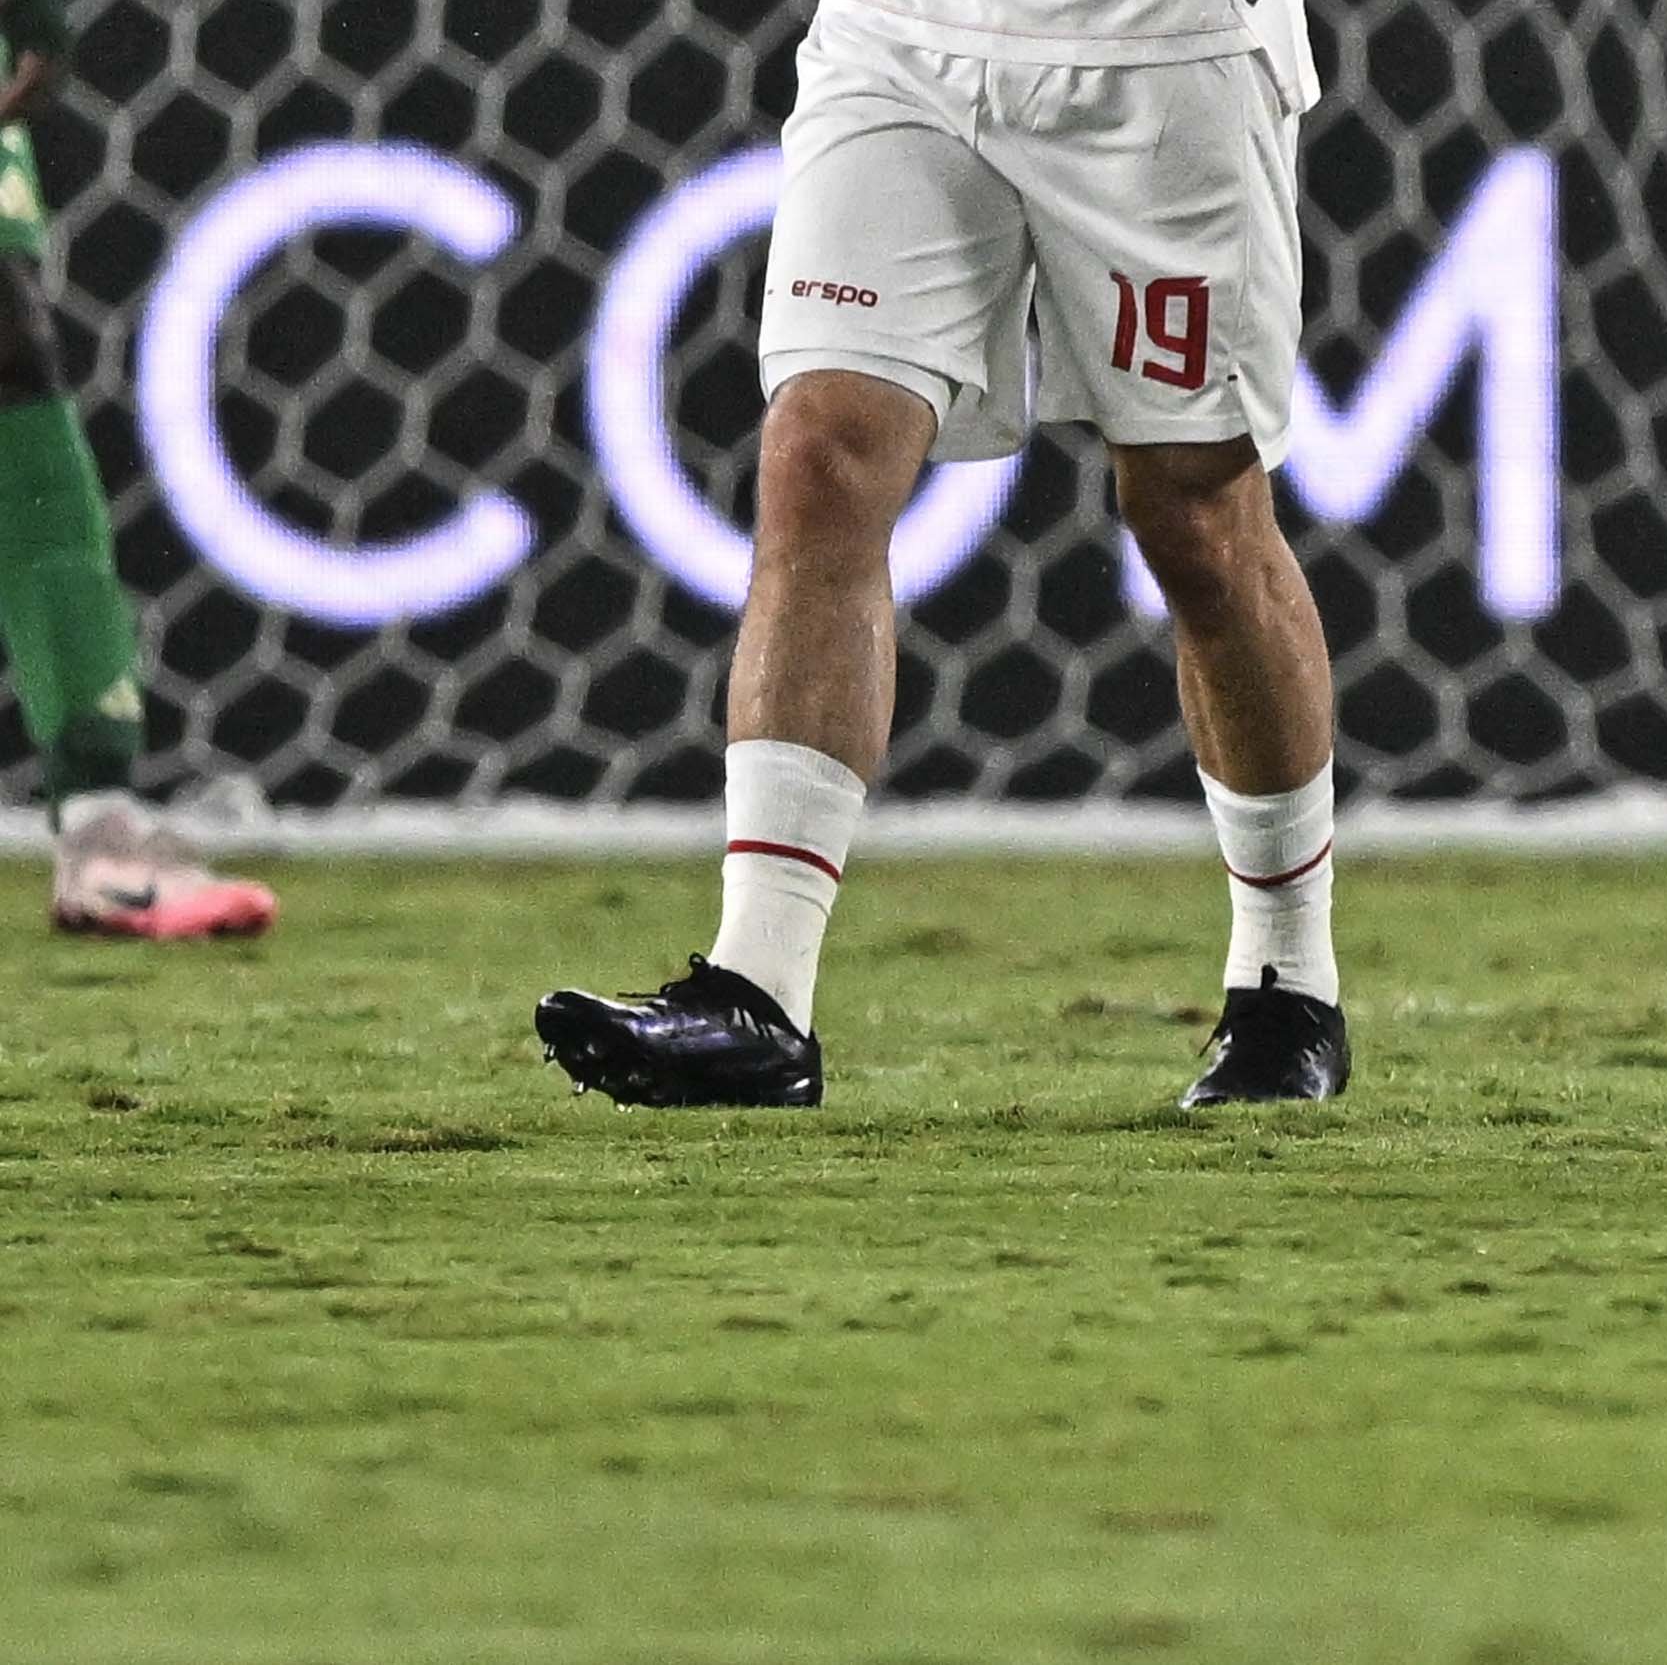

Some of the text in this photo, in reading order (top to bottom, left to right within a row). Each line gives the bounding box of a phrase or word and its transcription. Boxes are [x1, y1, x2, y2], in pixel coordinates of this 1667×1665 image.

[791, 279, 879, 308] erspo
[1109, 269, 1209, 390] 19
[138, 142, 1561, 624] COM
